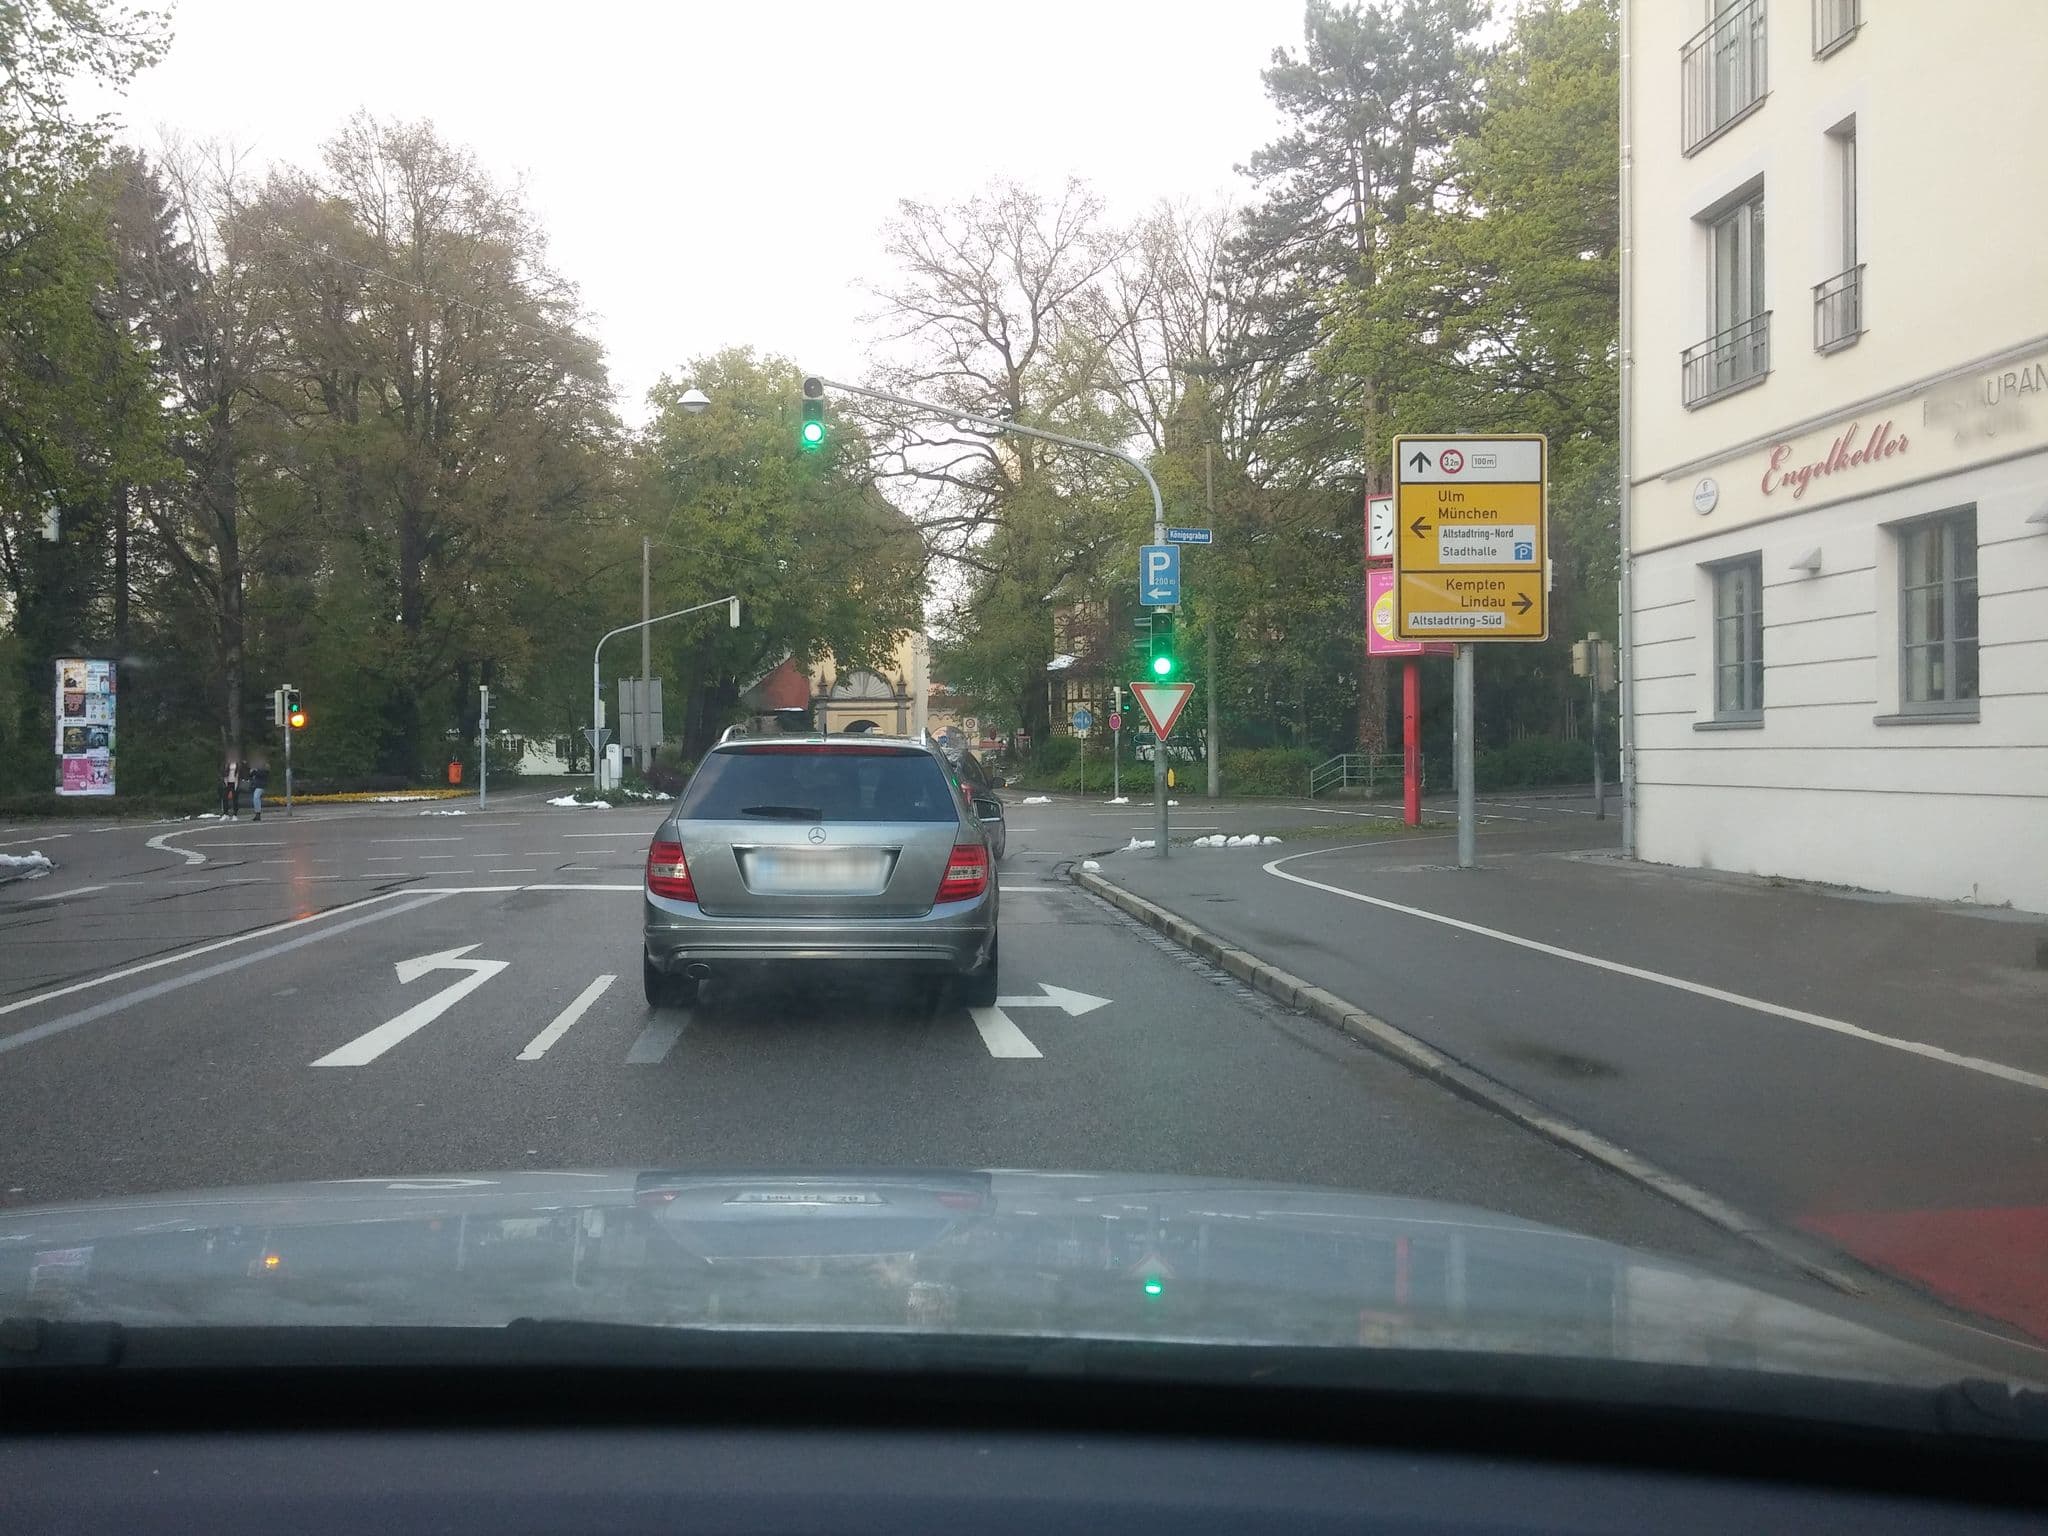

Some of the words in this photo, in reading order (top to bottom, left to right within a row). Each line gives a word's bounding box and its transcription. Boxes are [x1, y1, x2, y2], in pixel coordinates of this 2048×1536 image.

[1761, 421, 1909, 499] Engelkeller
[1438, 490, 1465, 502] Ulm
[1438, 507, 1498, 520] München
[1170, 530, 1209, 540] Königsgraben
[1442, 529, 1514, 540] Altstadtring-Nord
[1442, 546, 1498, 557] Stadthalle
[1148, 551, 1171, 586] P
[1445, 579, 1506, 593] Kempten
[1460, 596, 1506, 608] Lindau
[1411, 614, 1502, 627] Altstadtring-Süd
